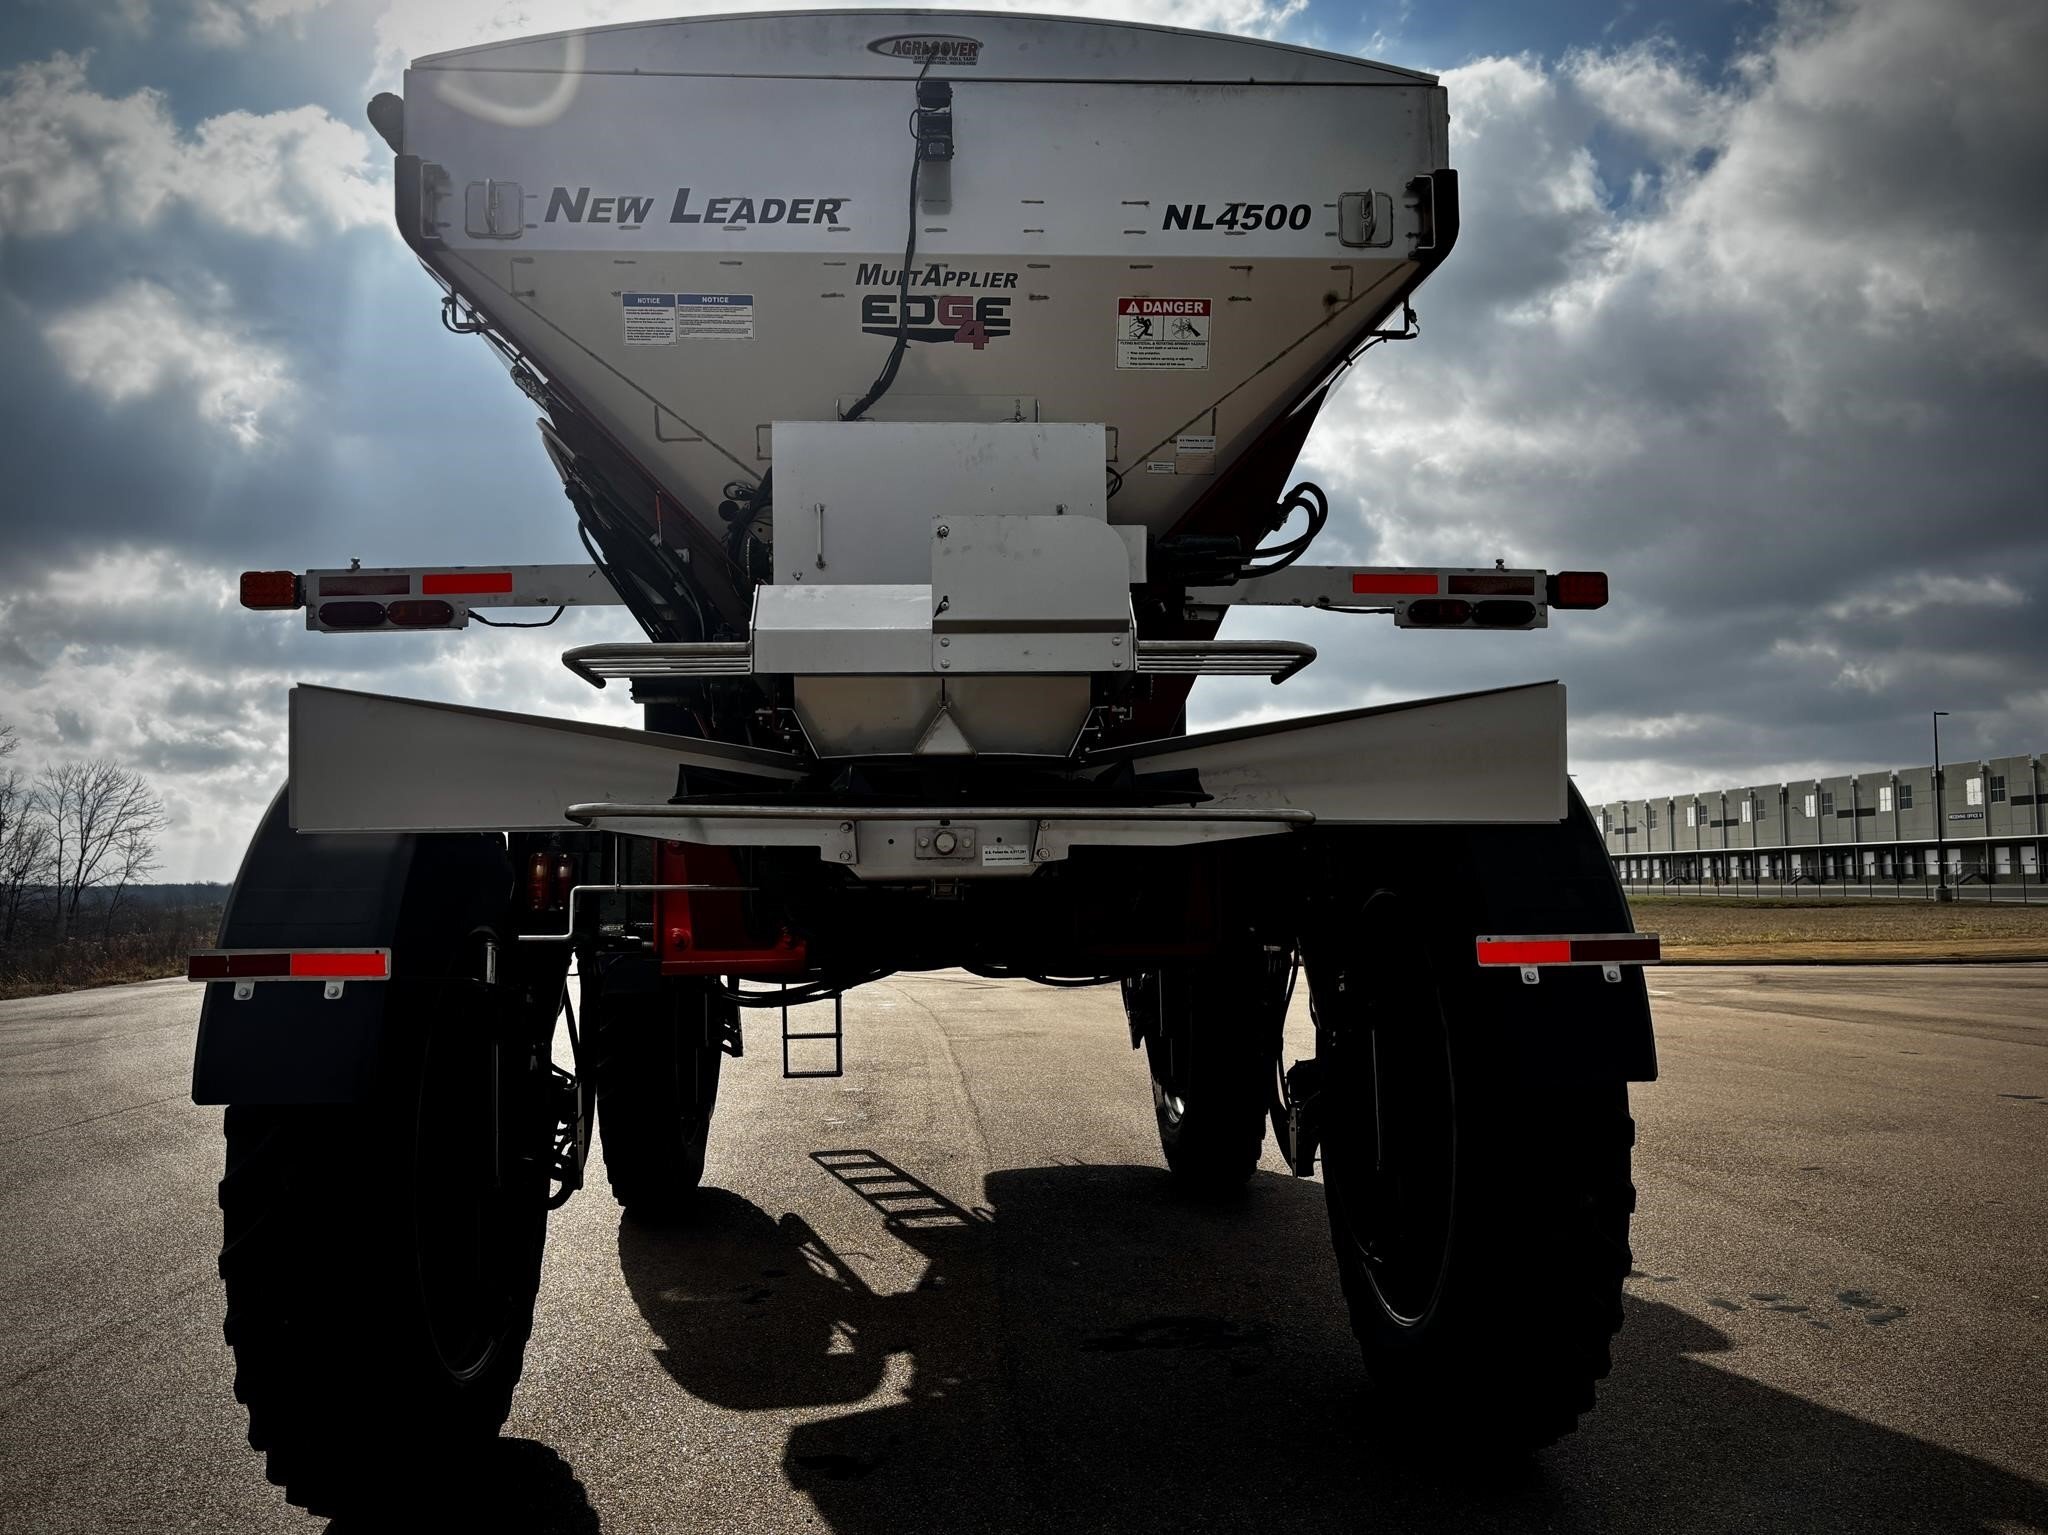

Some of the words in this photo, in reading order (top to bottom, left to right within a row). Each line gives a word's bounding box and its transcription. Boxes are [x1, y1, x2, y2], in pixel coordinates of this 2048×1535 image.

[544, 187, 654, 224] NEW
[669, 187, 841, 225] LEADER
[1162, 204, 1312, 231] NL4500
[862, 294, 1011, 327] EDGE
[1143, 301, 1204, 313] DANGER
[953, 319, 989, 350] 4
